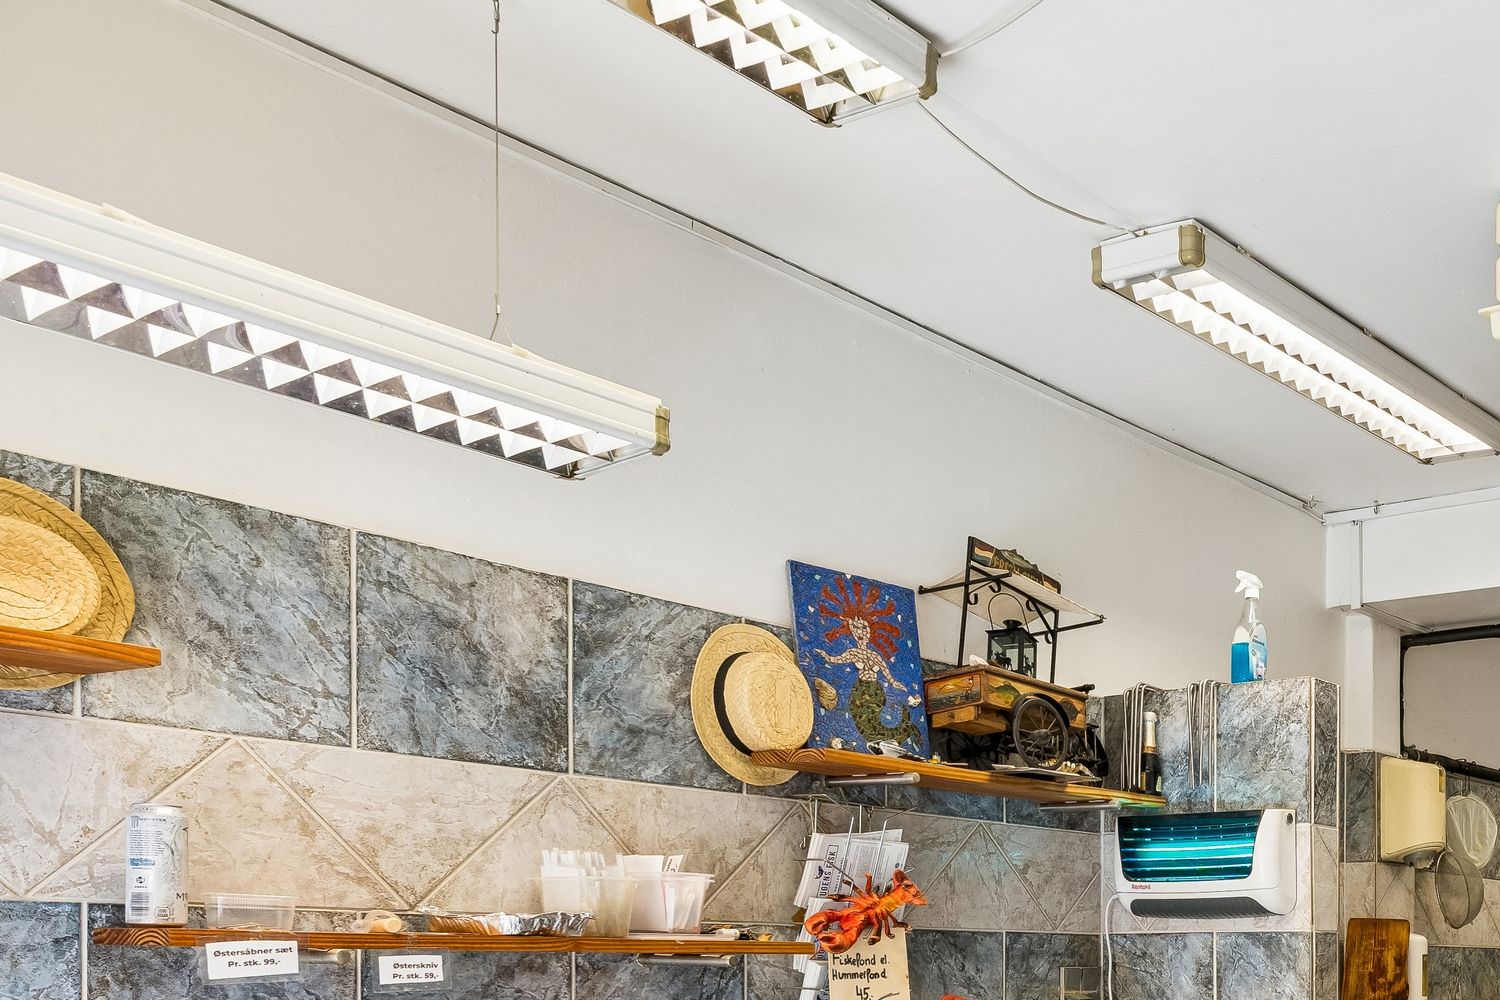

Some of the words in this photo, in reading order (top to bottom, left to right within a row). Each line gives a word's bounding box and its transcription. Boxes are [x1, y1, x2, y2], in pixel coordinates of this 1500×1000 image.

[213, 948, 273, 957] Østersåbner
[264, 958, 281, 966] 99,-
[832, 968, 887, 983] Hummerfond
